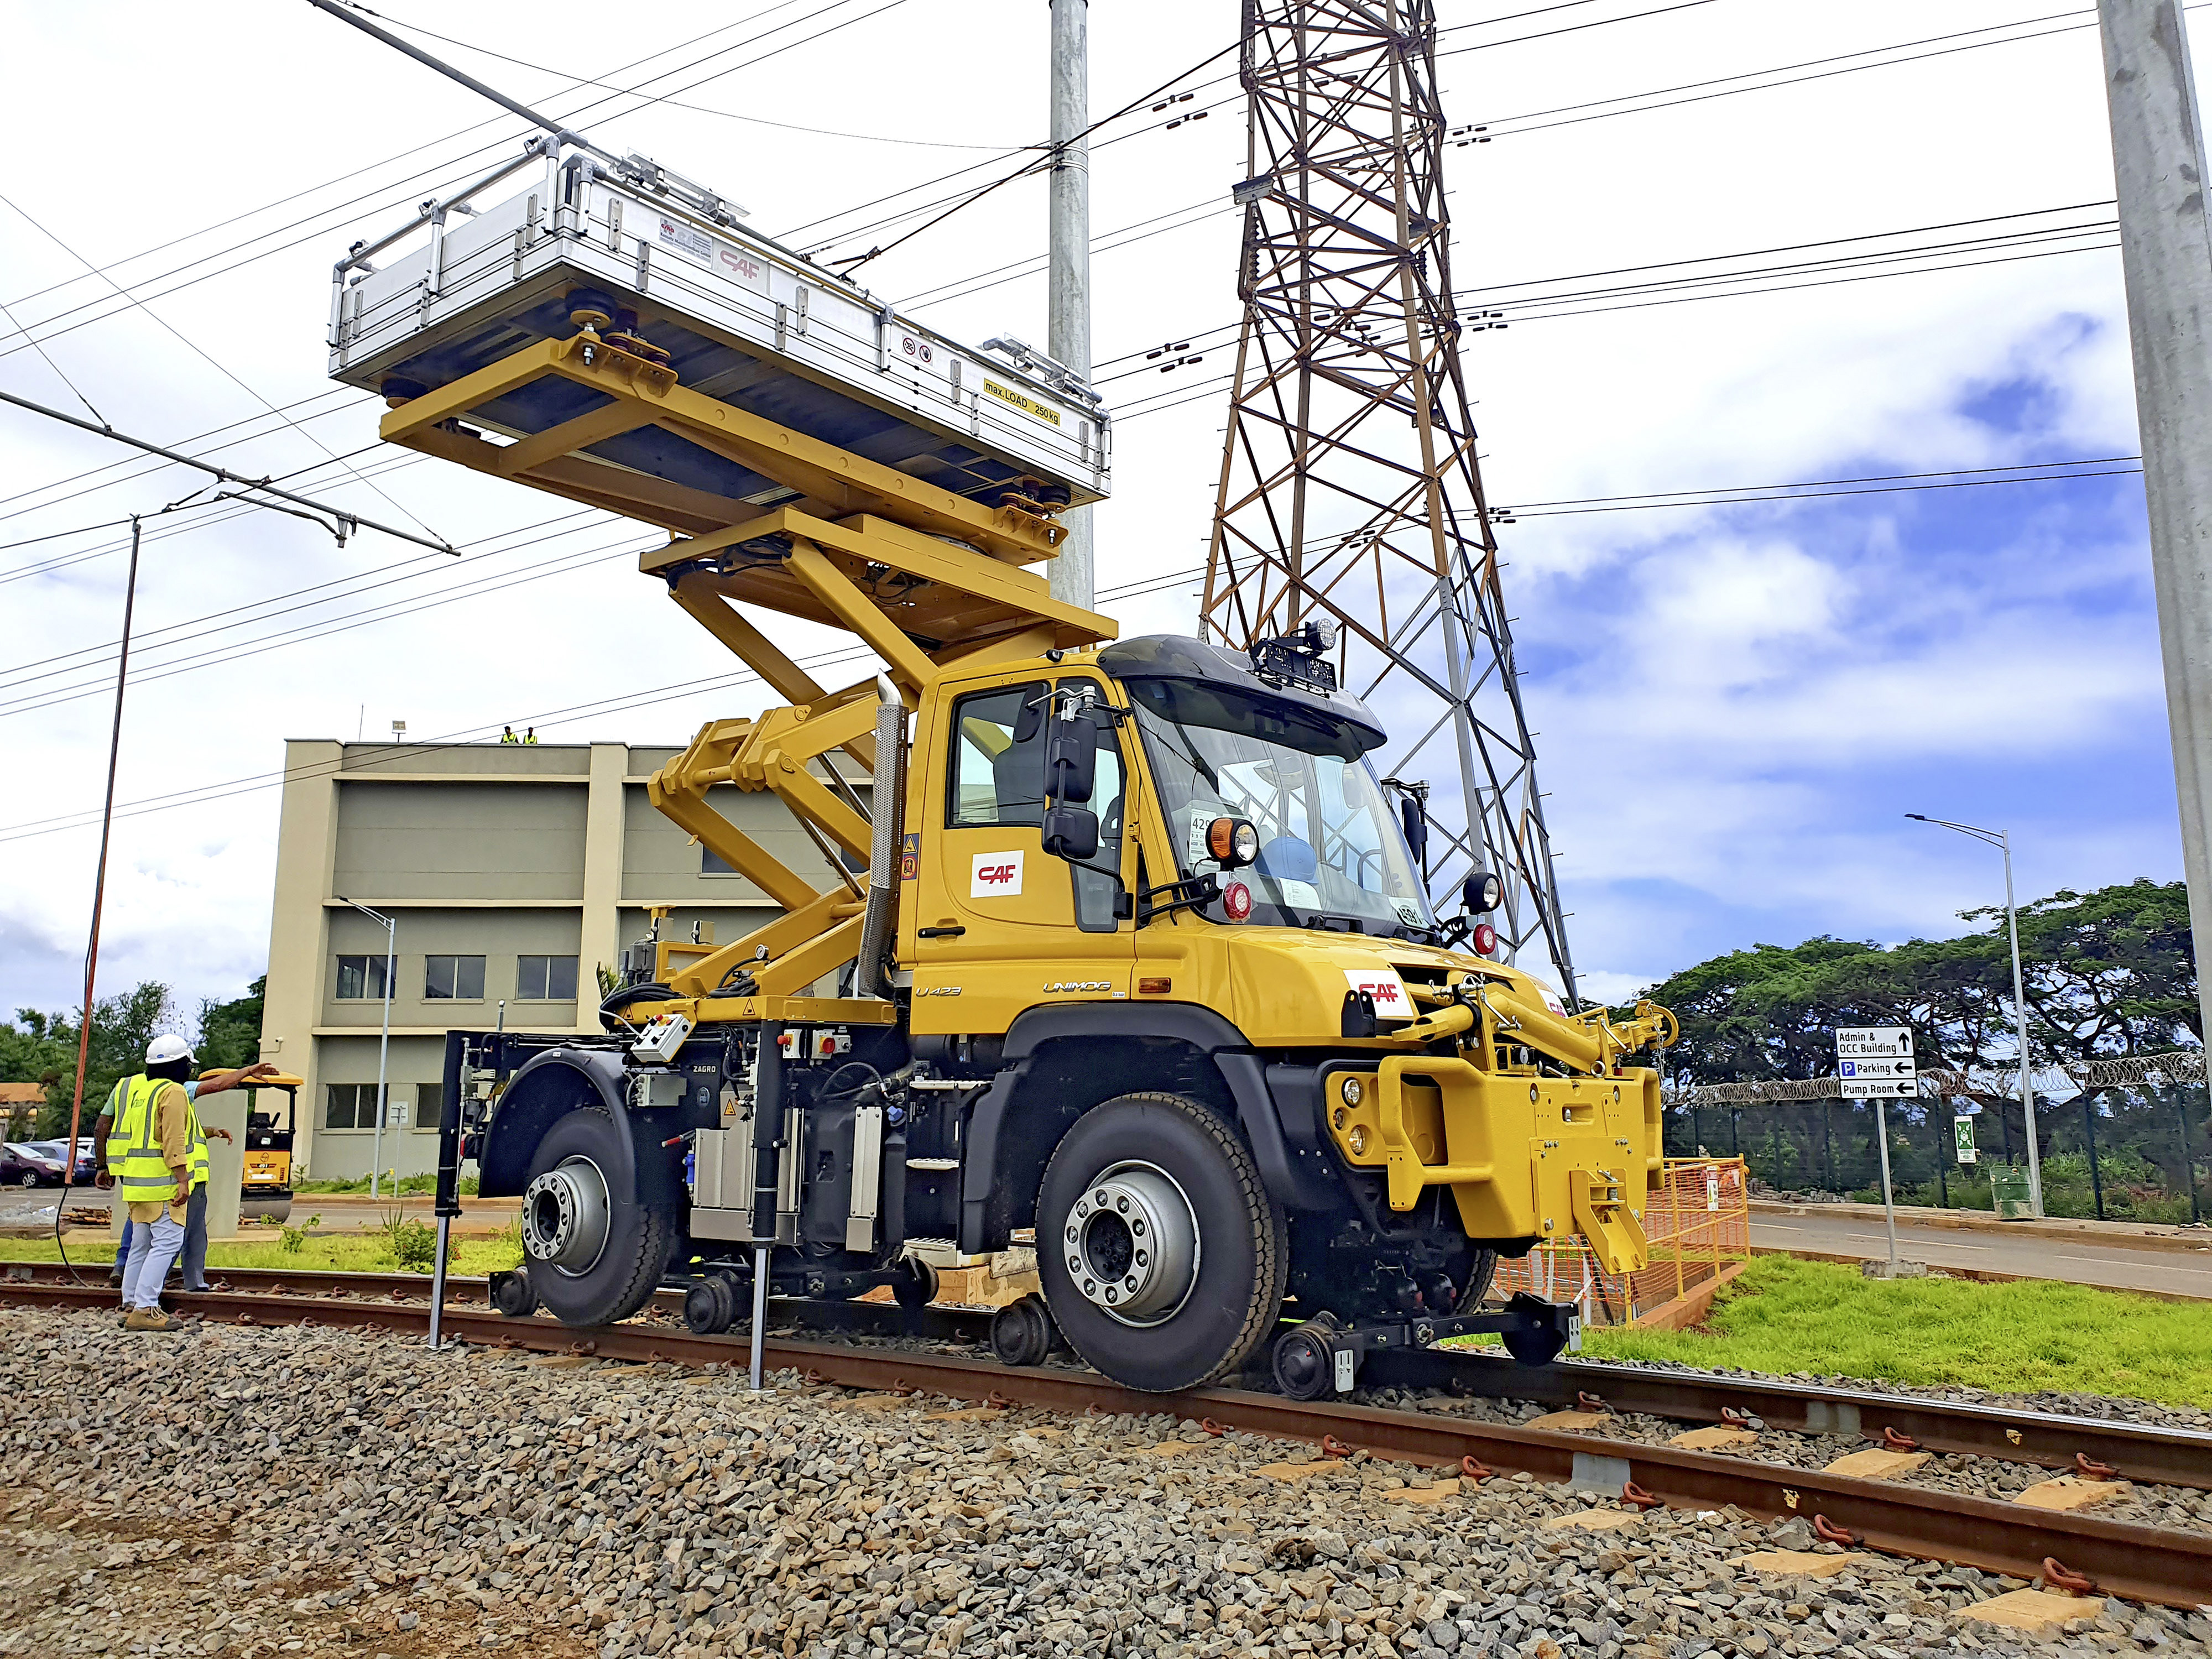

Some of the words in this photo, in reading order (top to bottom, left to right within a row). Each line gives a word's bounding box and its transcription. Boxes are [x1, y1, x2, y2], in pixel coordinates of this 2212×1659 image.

[720, 250, 759, 279] CAF
[978, 865, 1015, 884] CAF
[930, 987, 962, 997] 423
[1044, 981, 1112, 993] UNIMOG
[1359, 984, 1398, 1002] CAF
[1839, 1032, 1865, 1041] Admin
[1869, 1032, 1875, 1041] &
[1840, 1044, 1858, 1053] OCC
[1861, 1043, 1896, 1055] Building
[1844, 1063, 1853, 1074] P
[1858, 1063, 1890, 1075] Parking
[1844, 1085, 1867, 1096] Pump
[1870, 1084, 1894, 1093] Room
